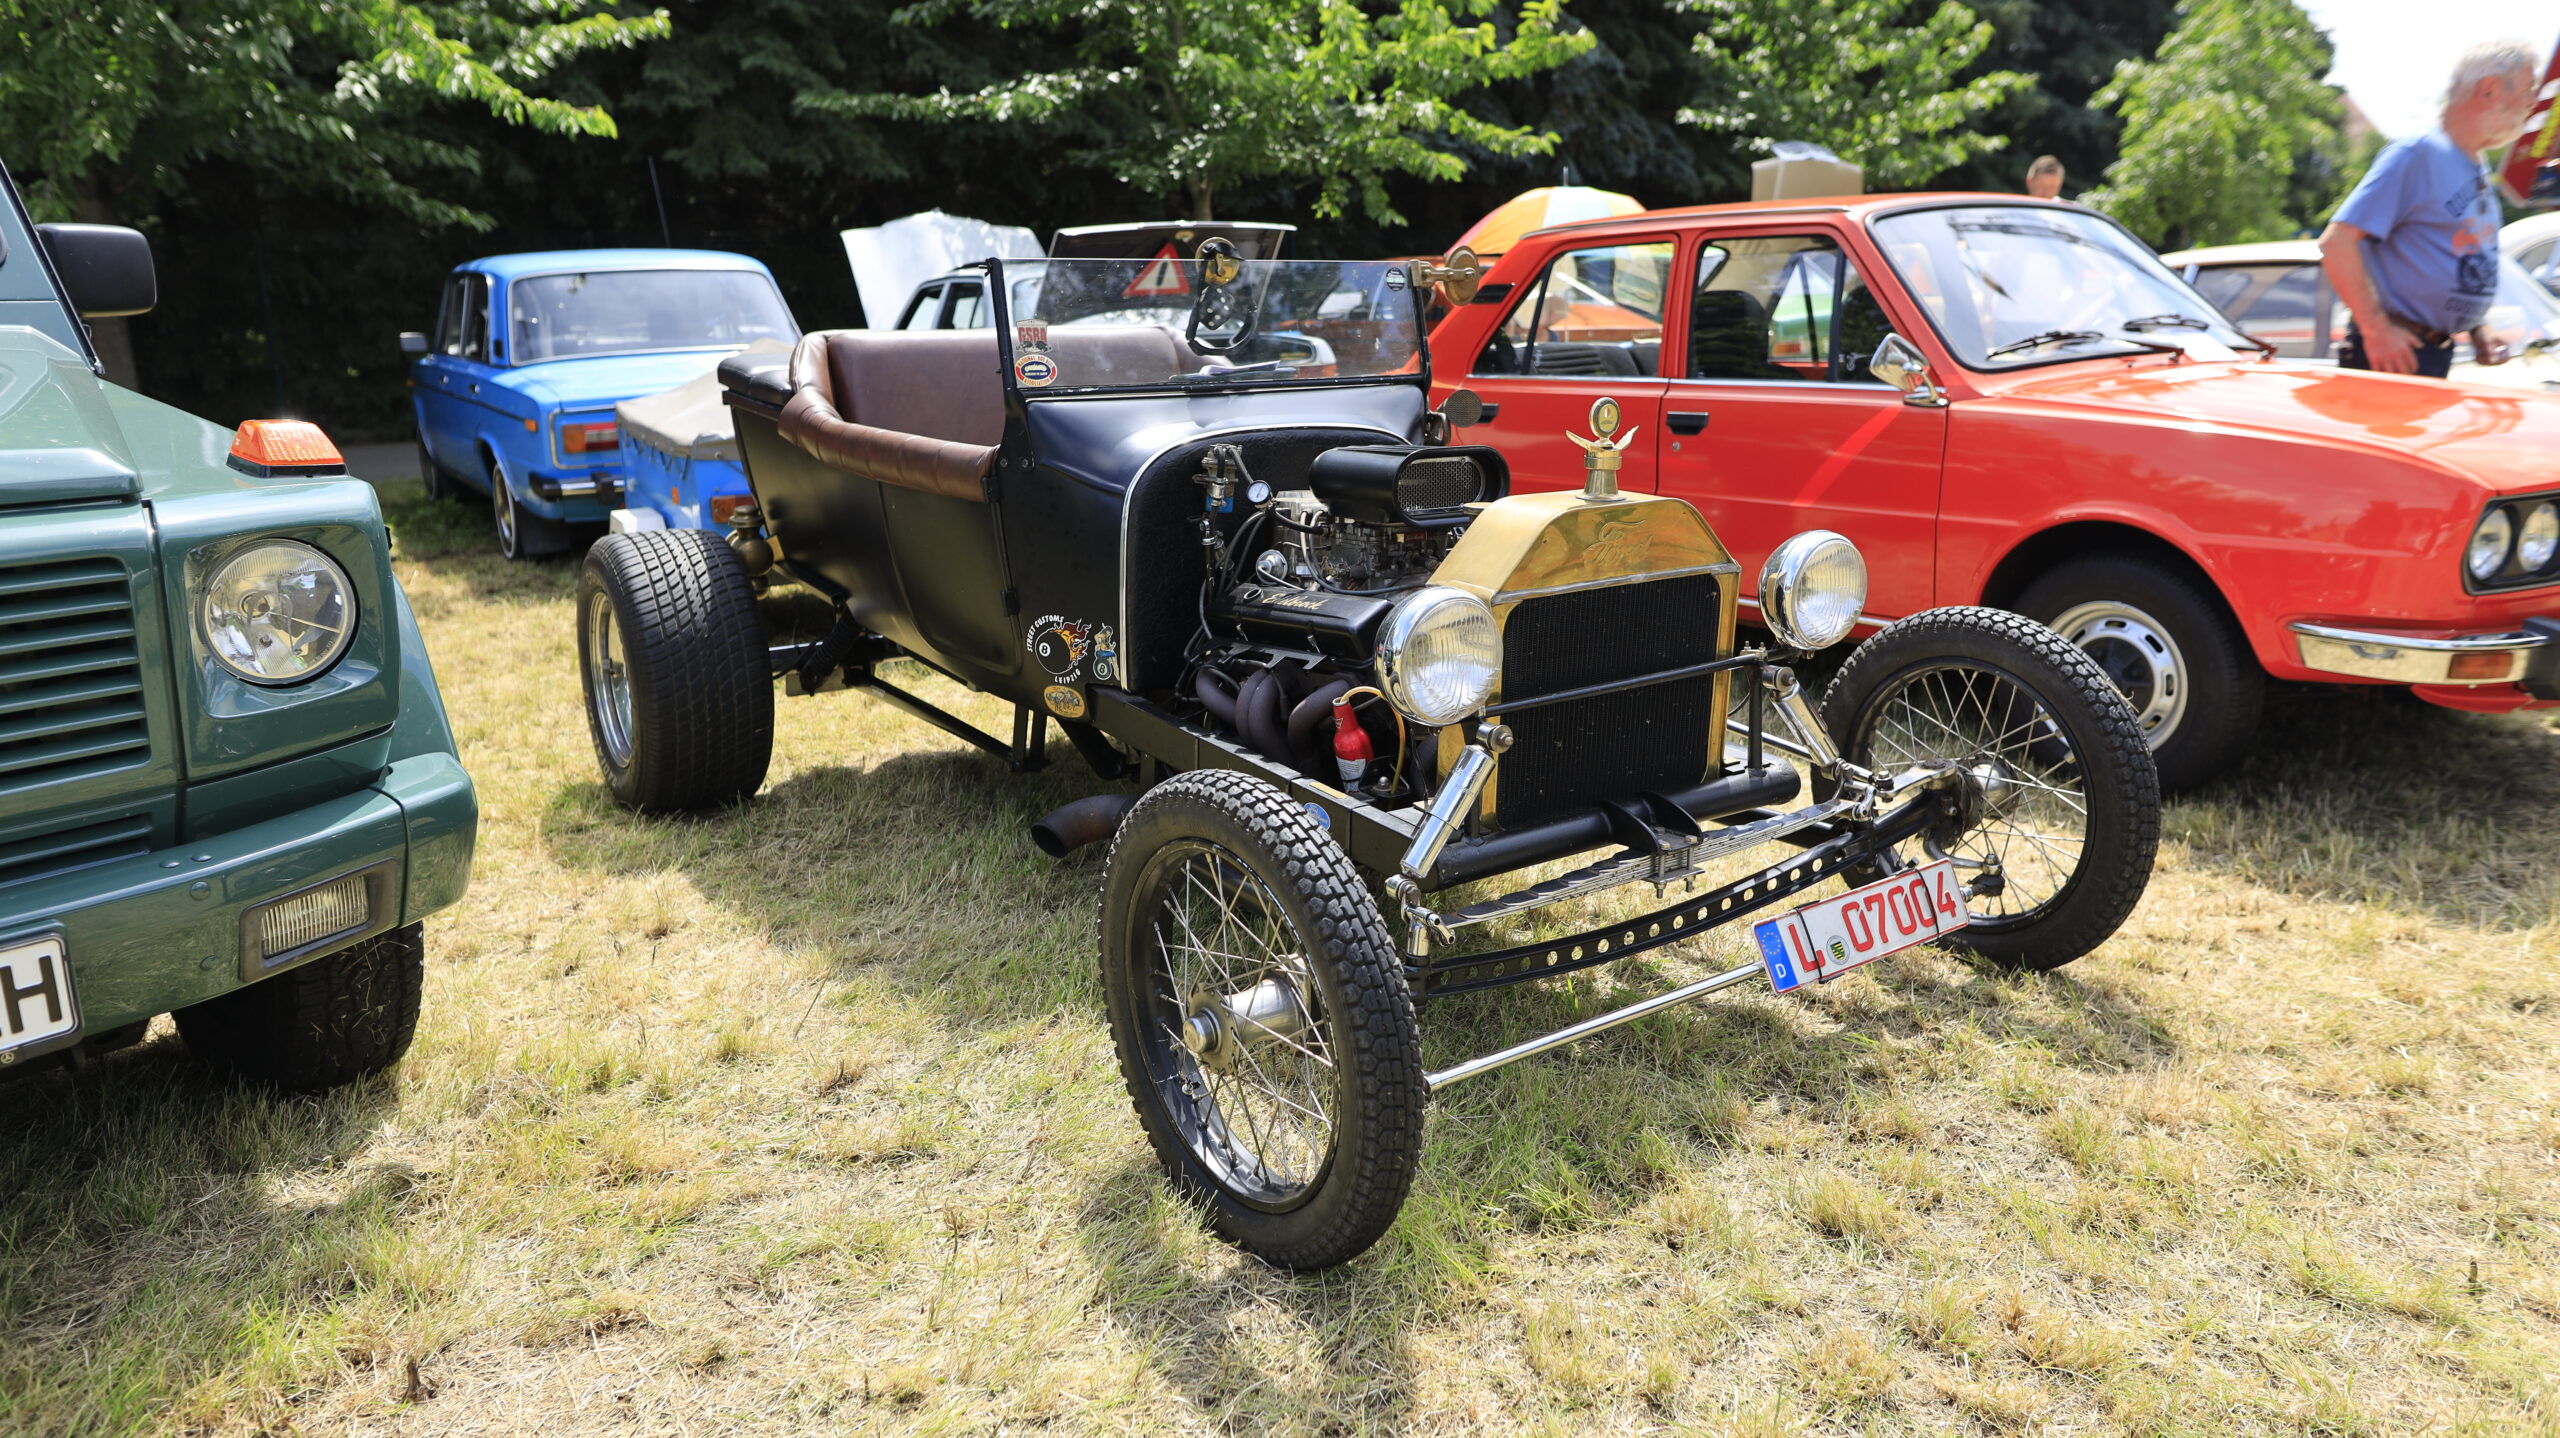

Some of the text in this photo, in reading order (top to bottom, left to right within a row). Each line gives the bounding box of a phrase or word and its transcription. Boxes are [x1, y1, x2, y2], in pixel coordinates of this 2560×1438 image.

[1018, 327, 1047, 343] GSRA
[1026, 614, 1064, 653] STREET CUSTOMS
[1054, 668, 1081, 685] LEIPZIG
[1788, 871, 1957, 973] L 07004
[1774, 963, 1787, 980] D
